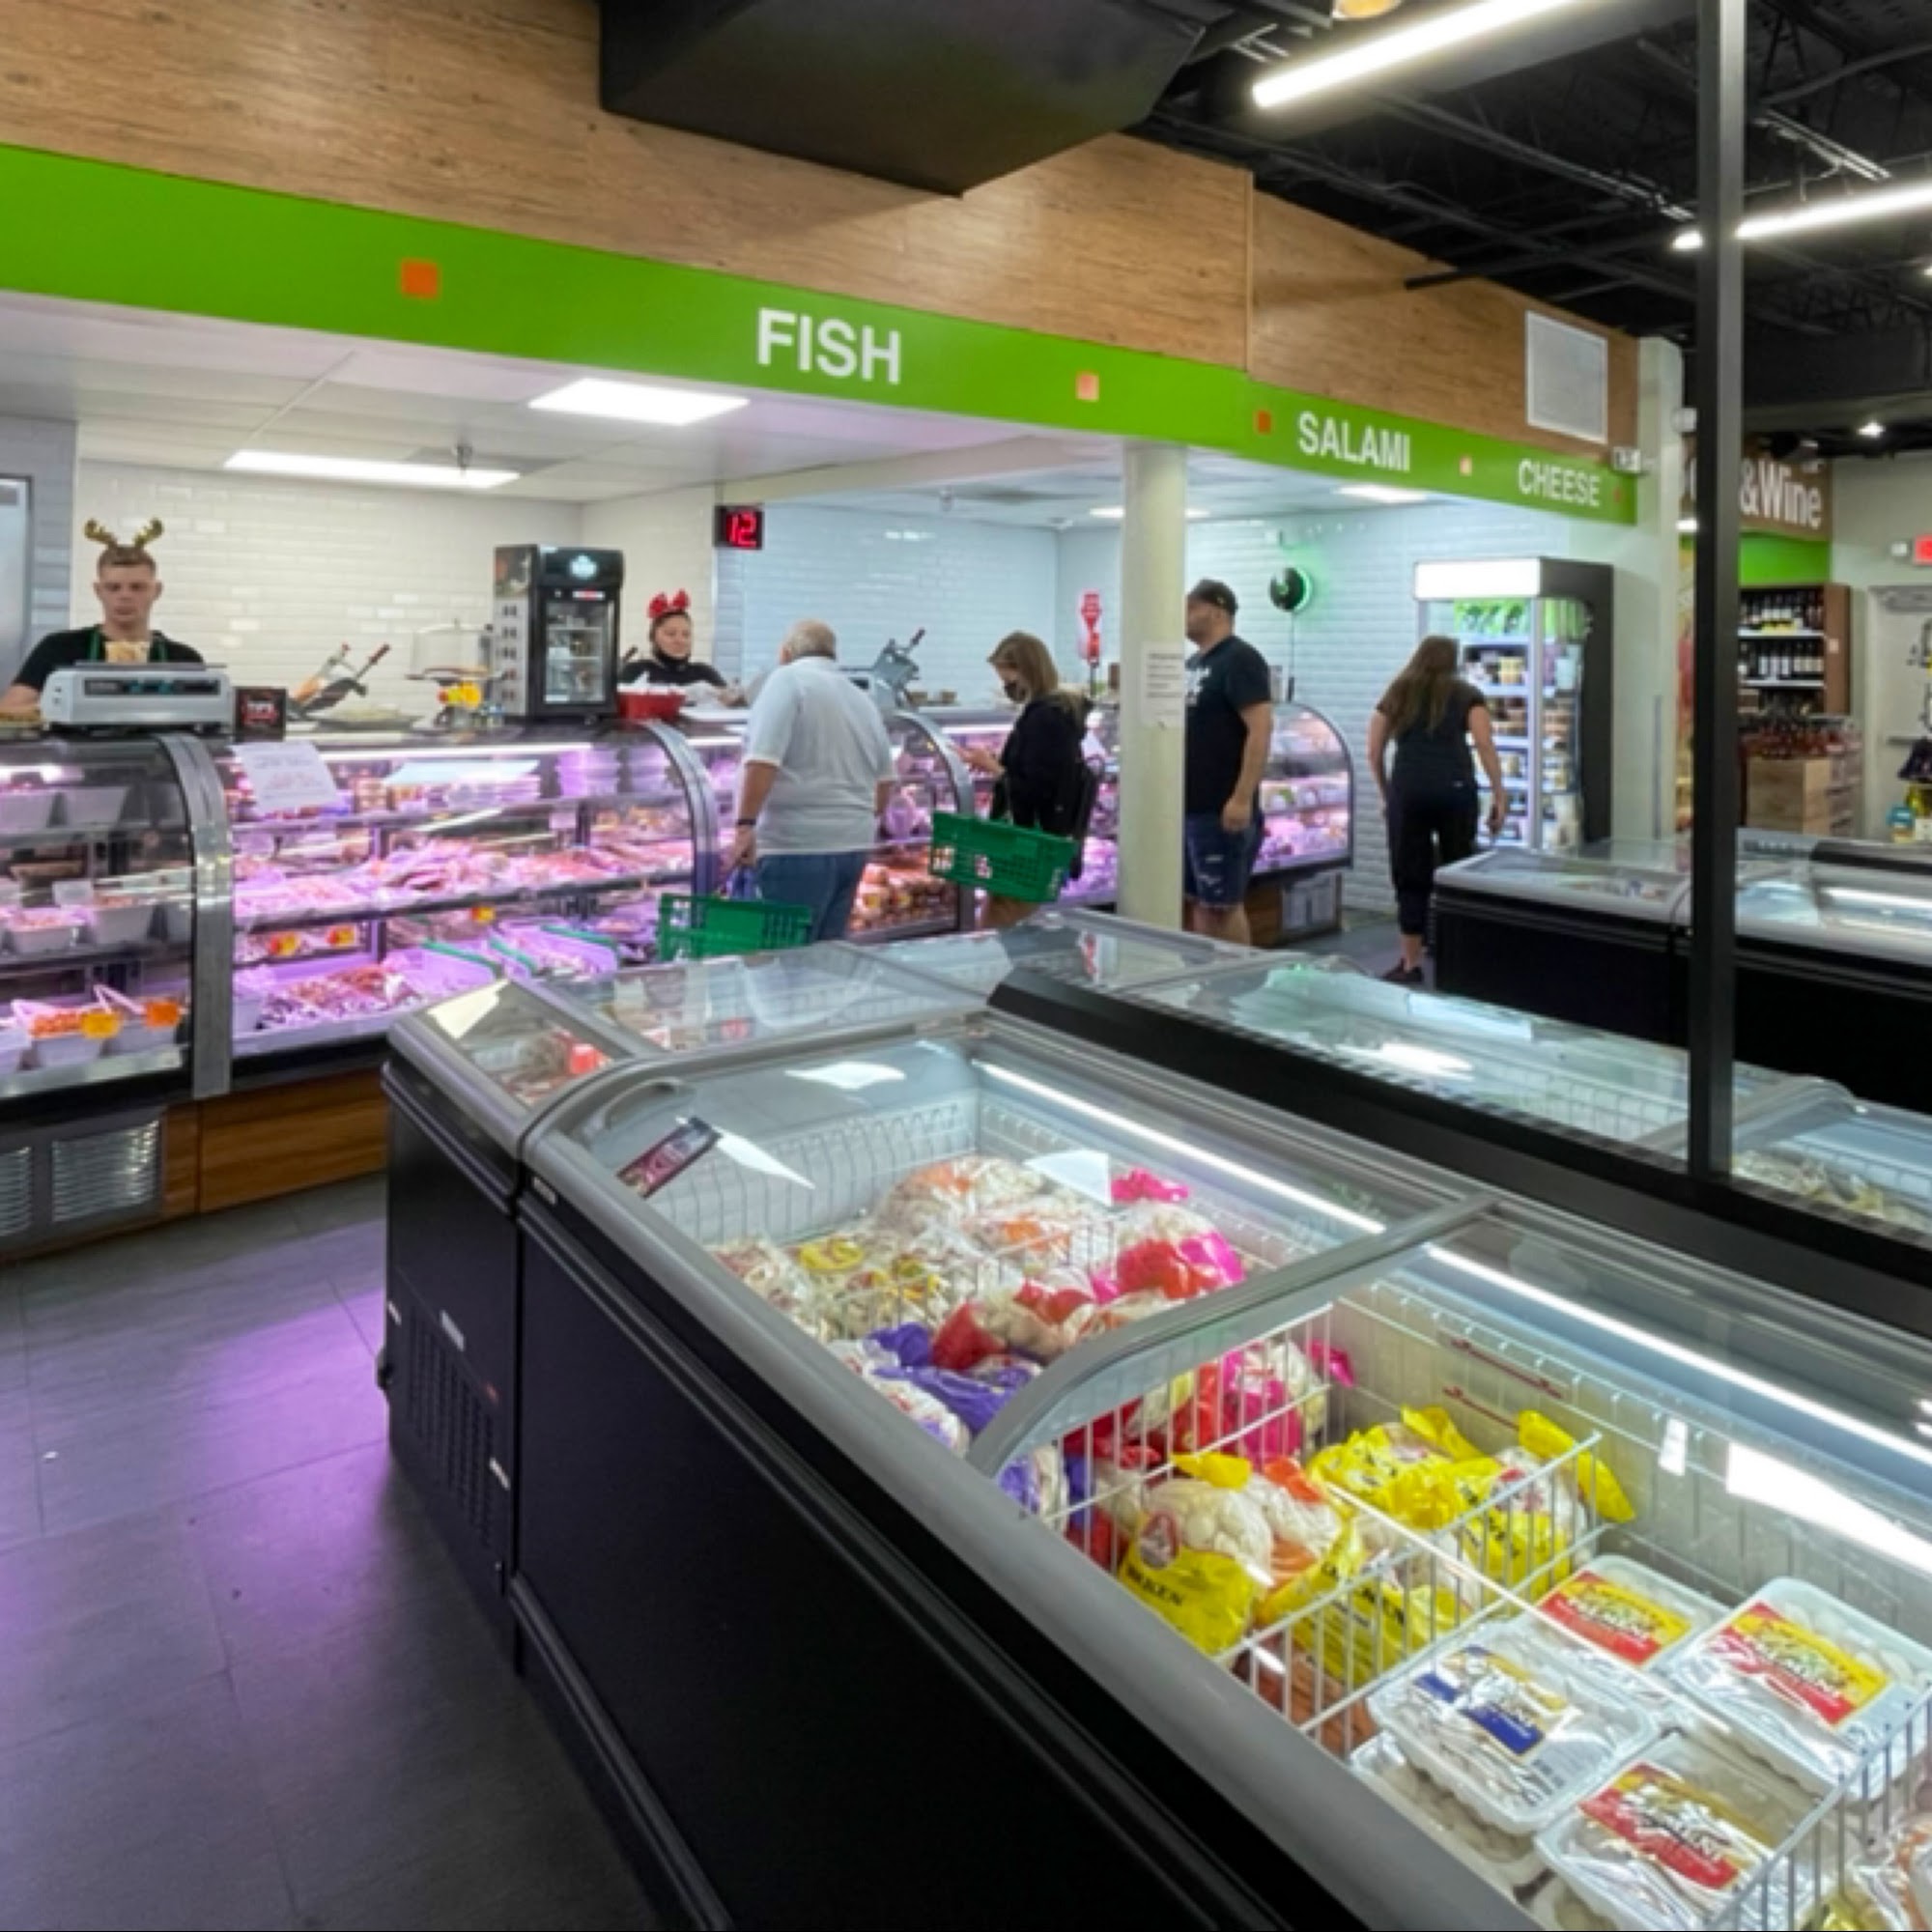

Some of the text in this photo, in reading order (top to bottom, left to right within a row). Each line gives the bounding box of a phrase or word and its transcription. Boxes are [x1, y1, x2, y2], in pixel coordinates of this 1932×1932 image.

[757, 307, 900, 384] FISH
[1298, 411, 1410, 472] SALAMI
[1518, 458, 1601, 507] CHEESE
[731, 511, 756, 547] 12
